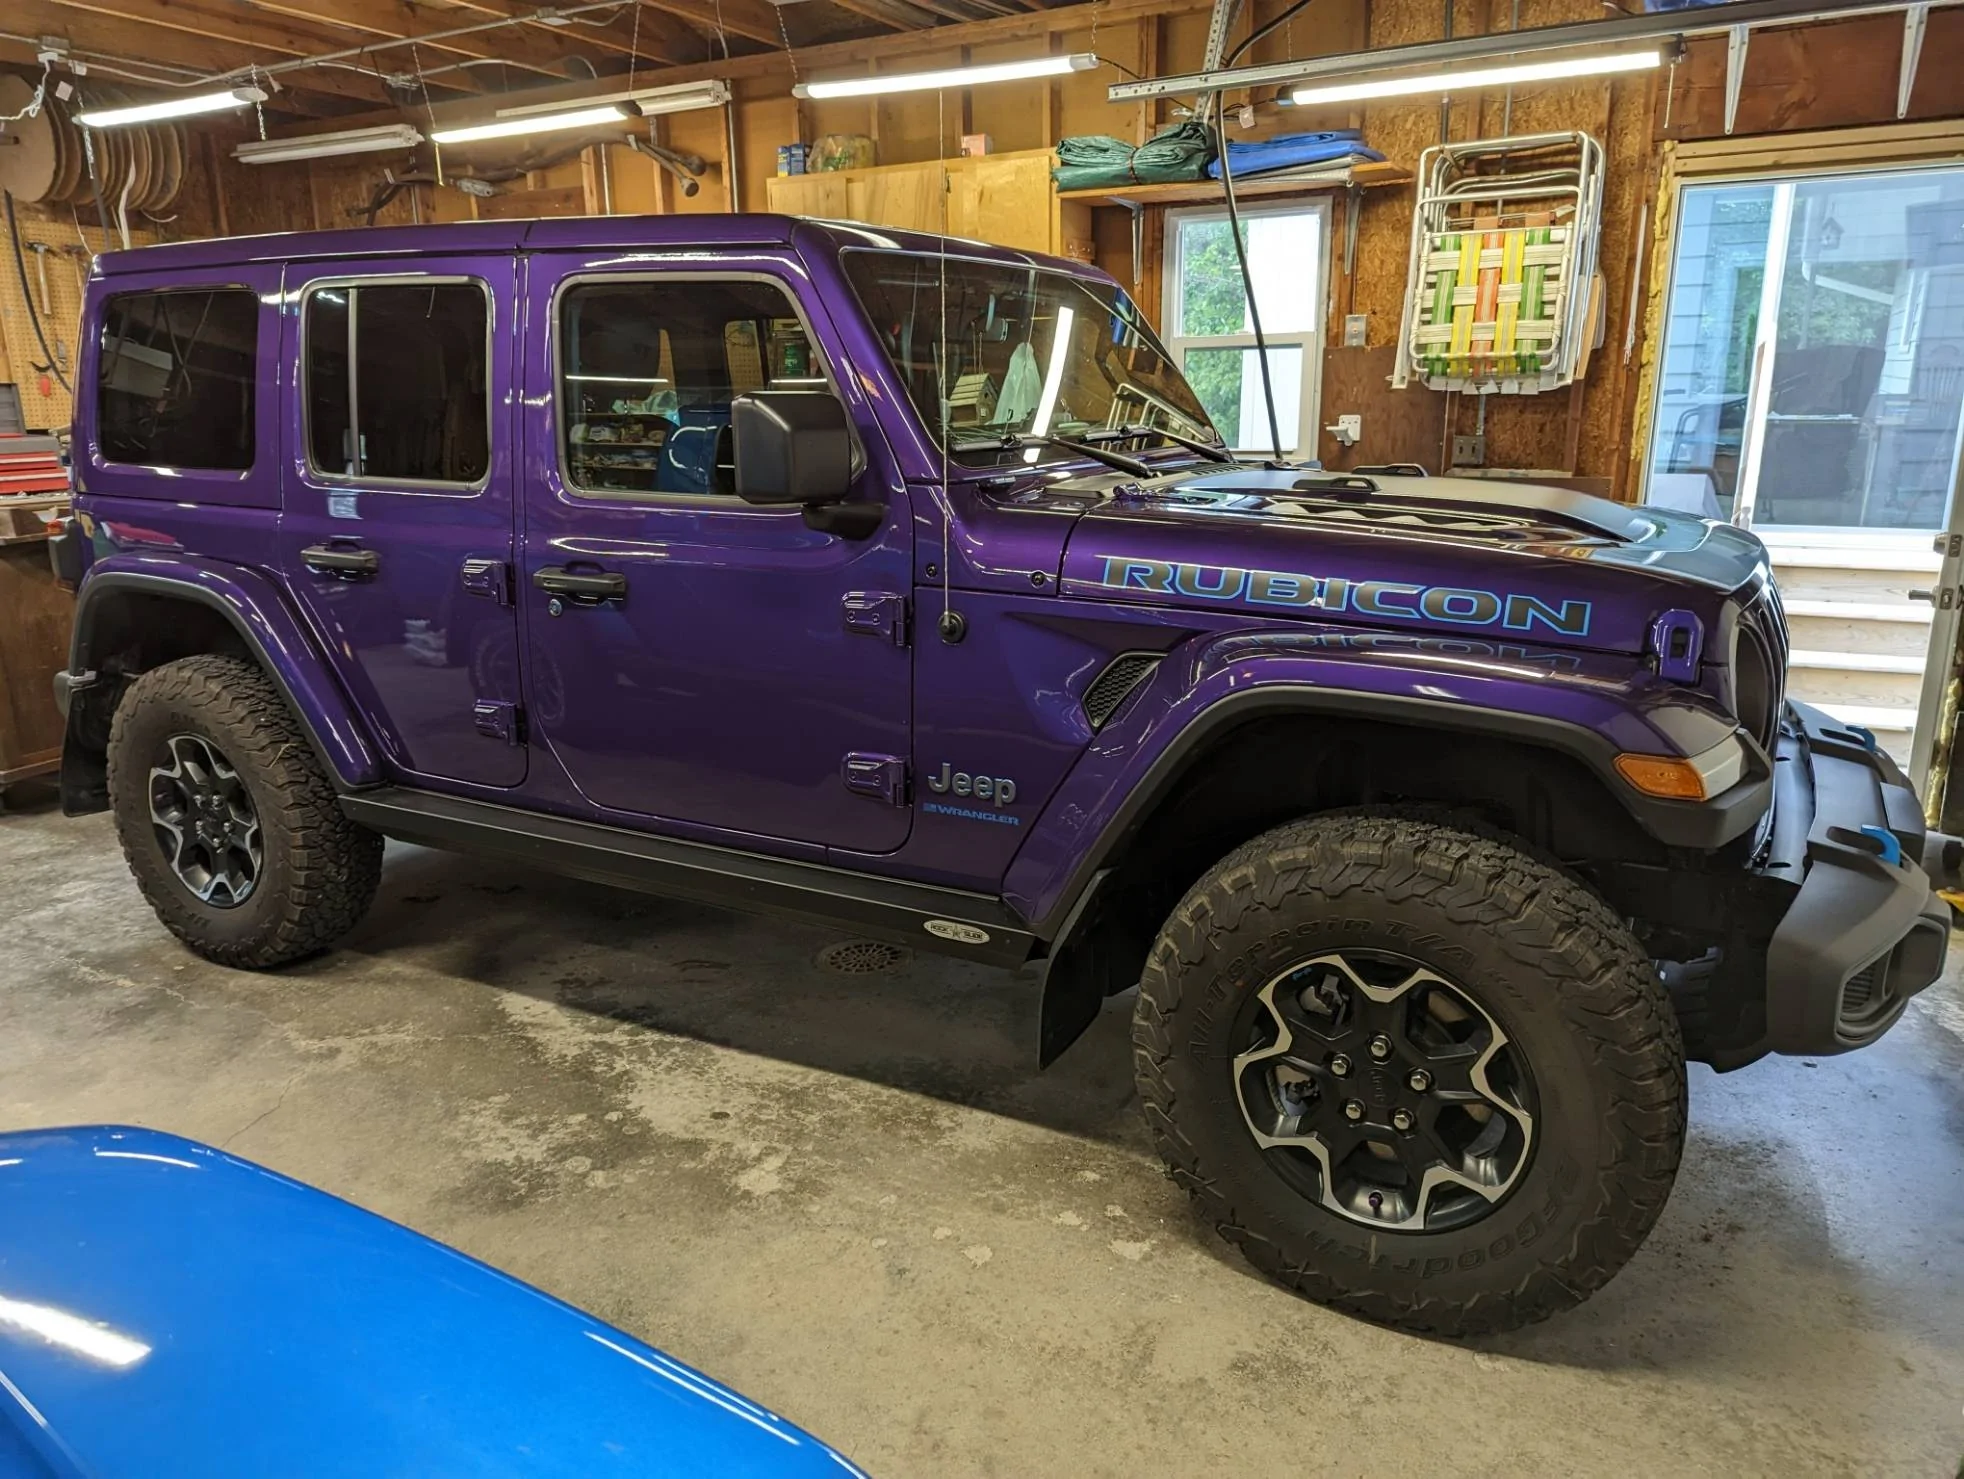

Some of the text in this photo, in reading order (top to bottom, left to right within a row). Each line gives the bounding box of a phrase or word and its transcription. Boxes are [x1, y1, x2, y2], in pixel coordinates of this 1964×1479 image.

[1101, 555, 1593, 637] RUBICON
[927, 761, 1018, 807] Jeep
[936, 804, 1020, 827] WRANGLER
